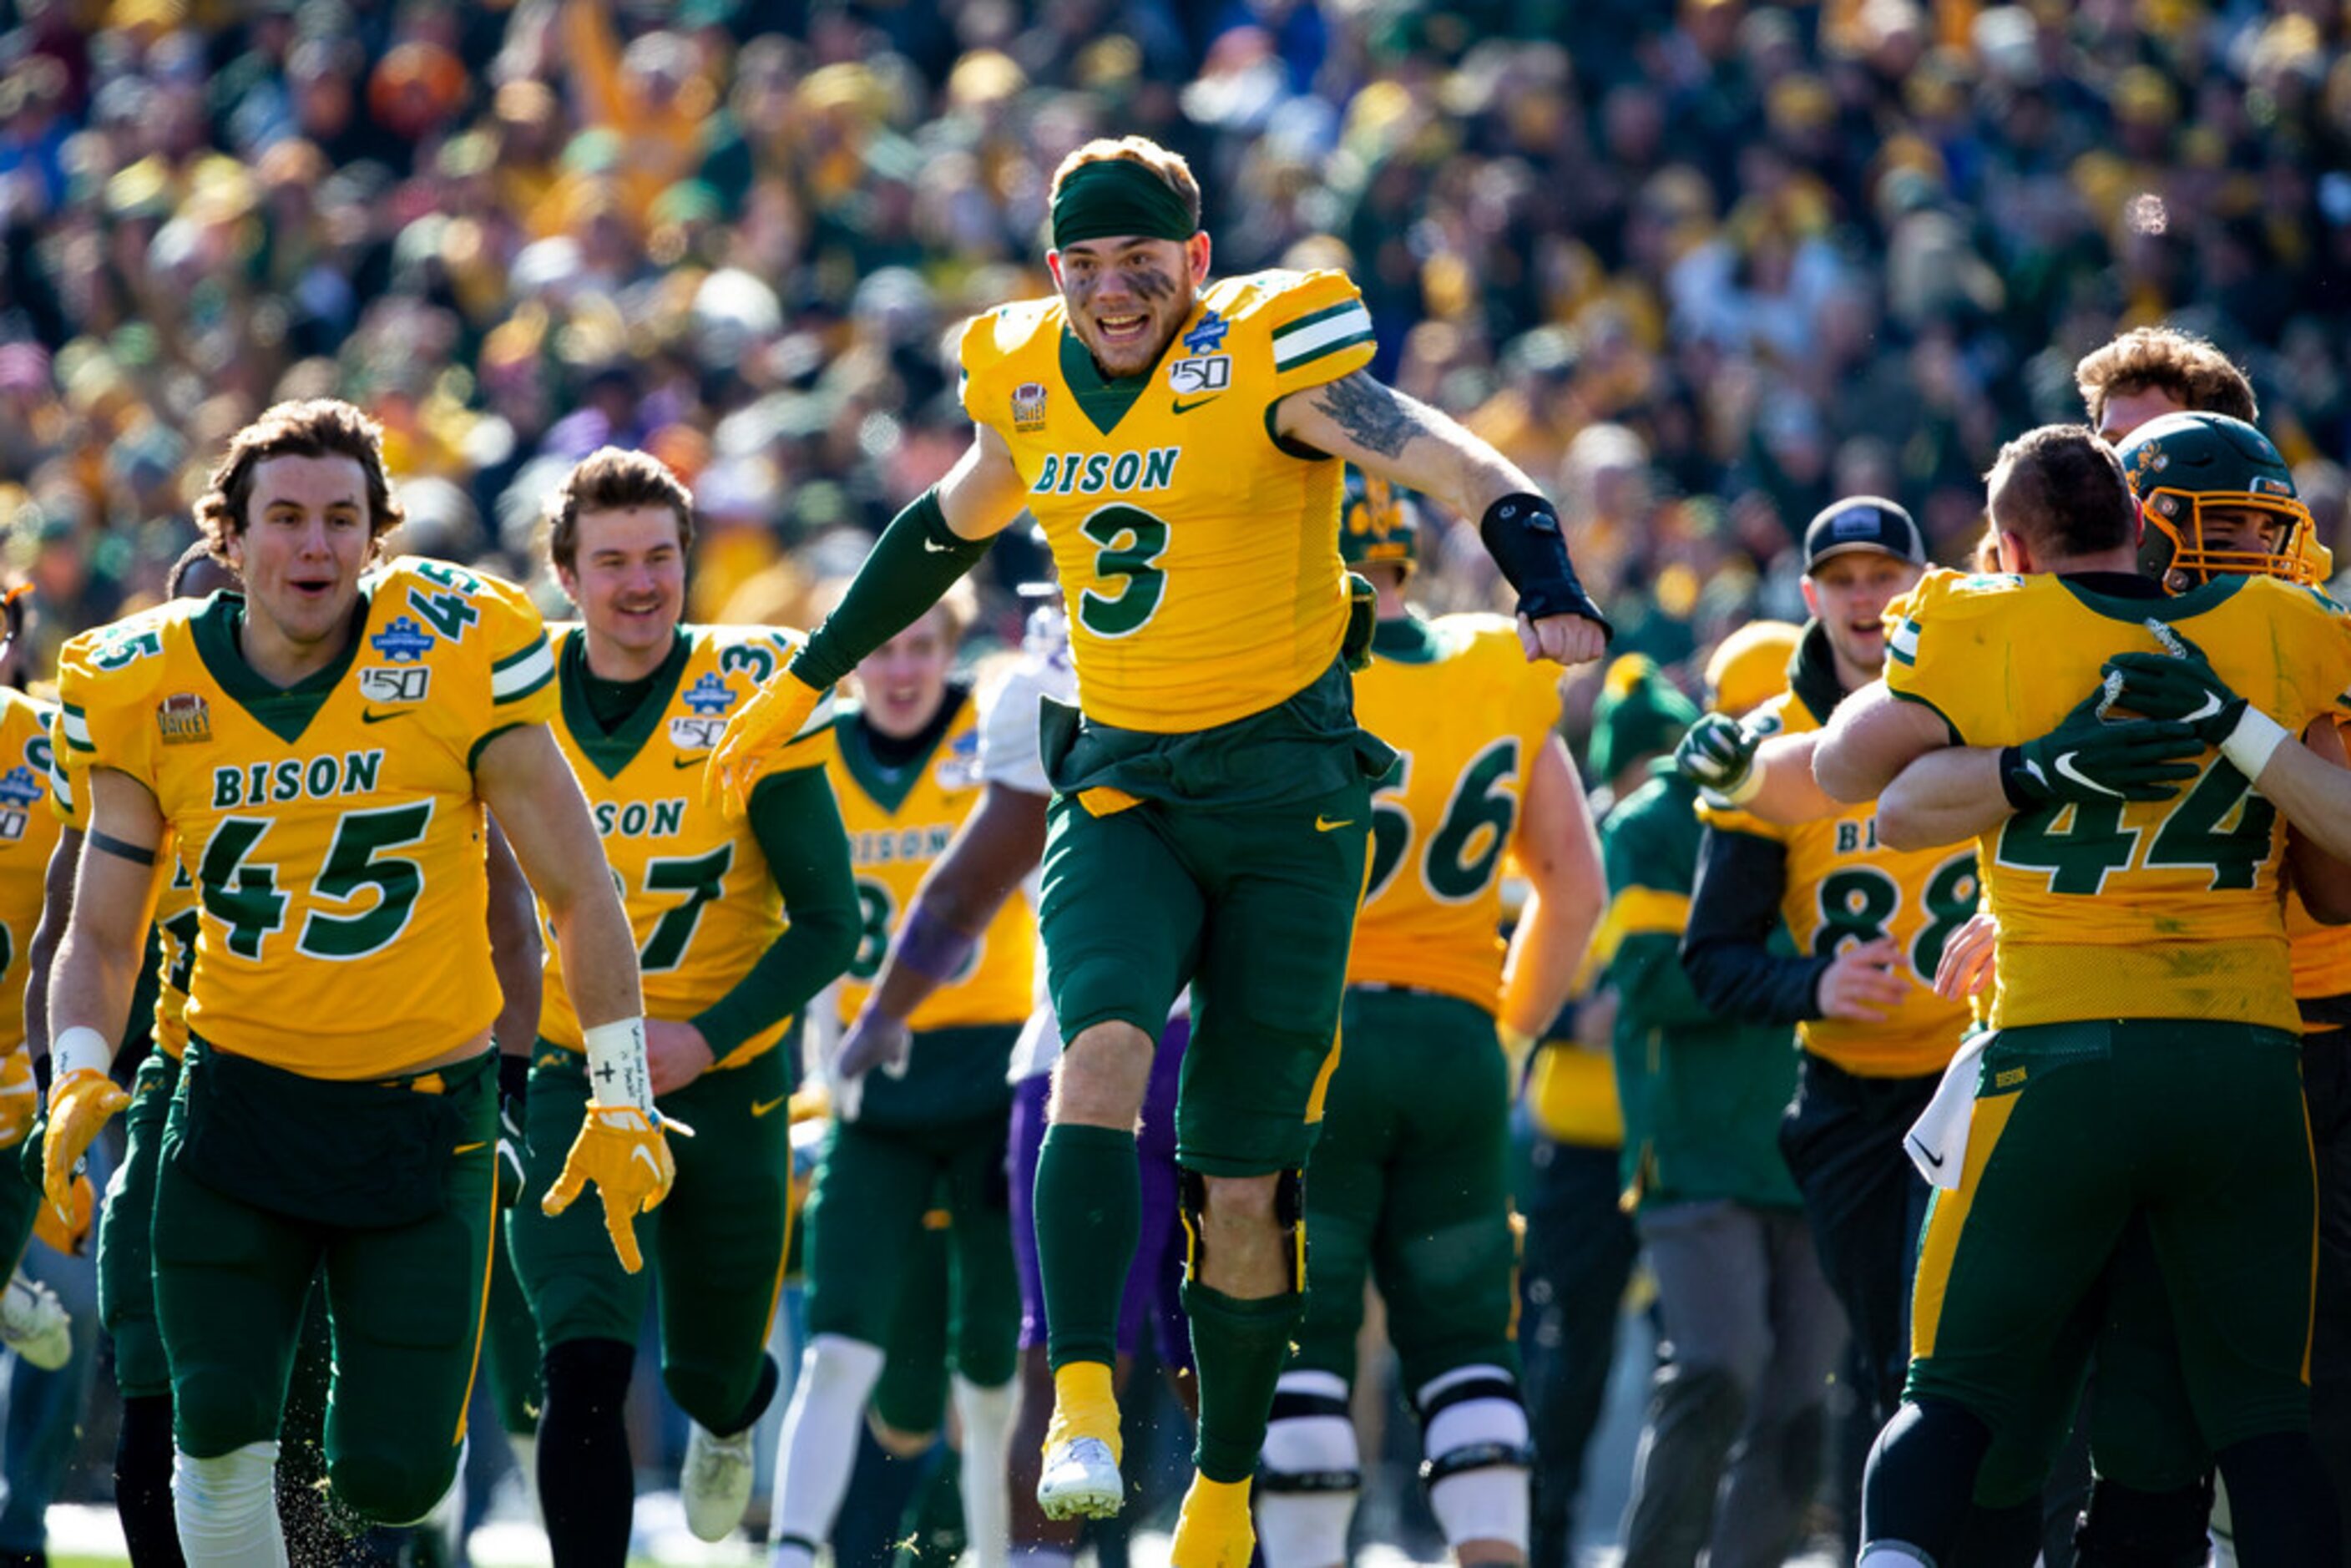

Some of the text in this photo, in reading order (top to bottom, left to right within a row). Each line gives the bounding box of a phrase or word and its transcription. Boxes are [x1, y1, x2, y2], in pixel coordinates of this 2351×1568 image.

[1170, 356, 1231, 393] 150
[1031, 446, 1181, 494] BISON
[407, 559, 482, 645] 45
[1079, 501, 1170, 639] 3
[357, 668, 432, 702] 150
[212, 749, 385, 810] BISON
[594, 797, 687, 838] SON
[849, 822, 953, 865] ISON
[1995, 752, 2278, 896] 44
[198, 796, 436, 964] 45
[612, 837, 736, 975] 7
[1812, 849, 1984, 986] 88
